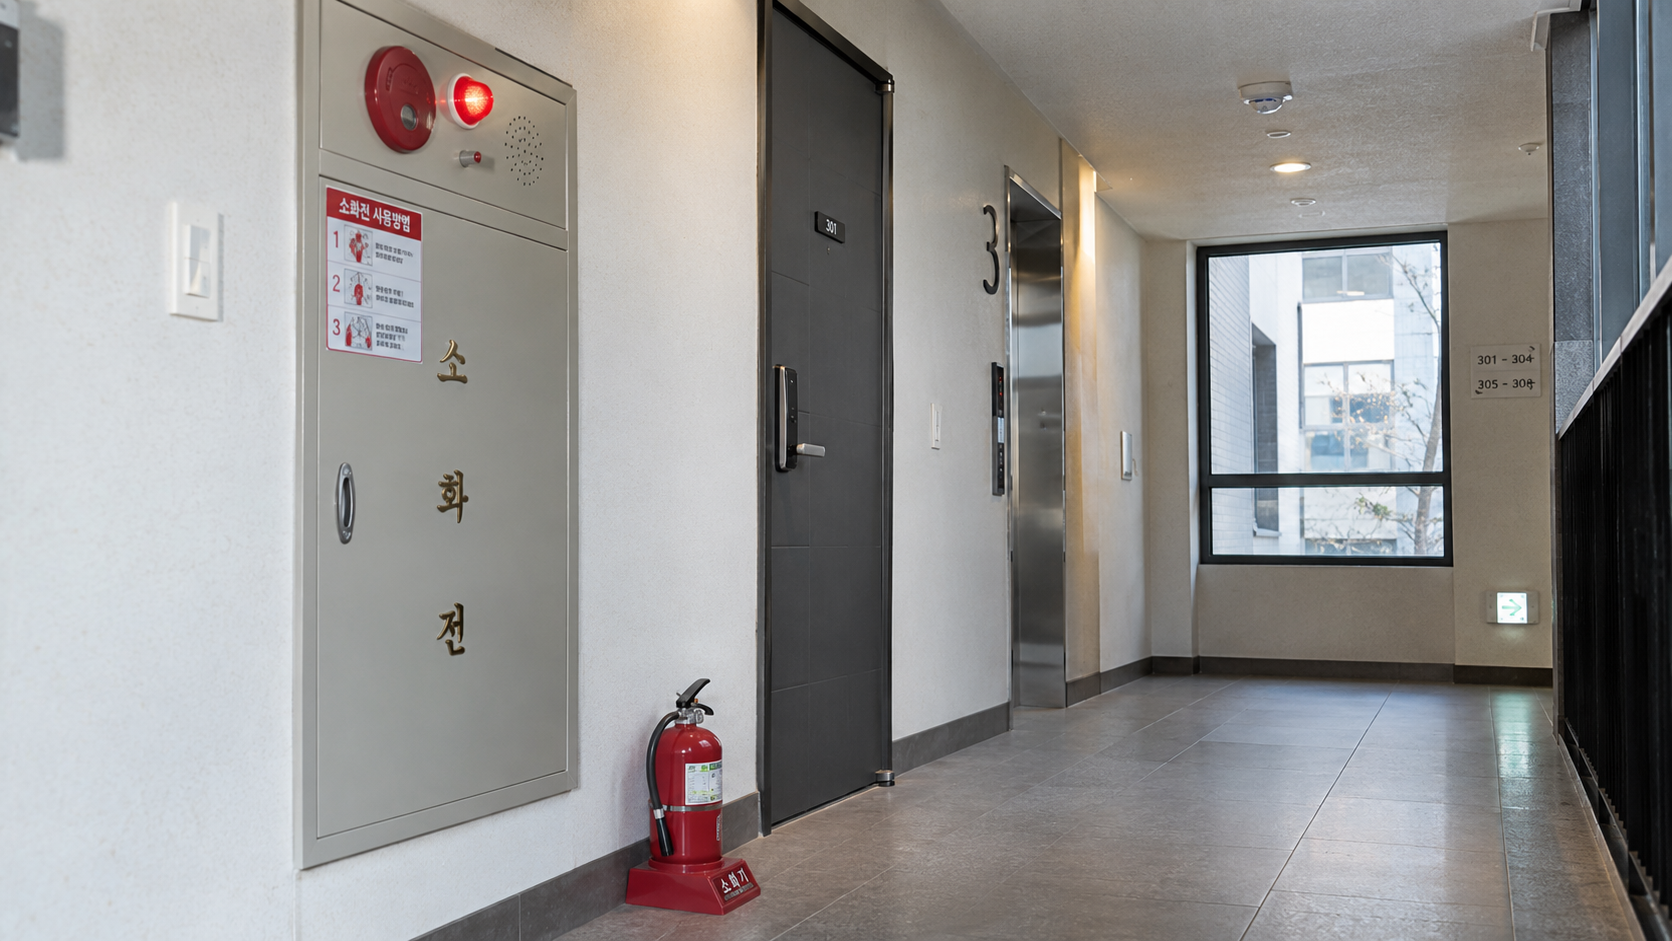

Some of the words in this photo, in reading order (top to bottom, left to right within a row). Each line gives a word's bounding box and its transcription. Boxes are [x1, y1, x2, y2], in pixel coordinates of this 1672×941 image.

[825, 218, 837, 235] 301
[333, 230, 339, 249] 1
[983, 205, 1000, 295] 3
[332, 274, 341, 293] 2
[332, 318, 341, 336] 3
[1477, 354, 1497, 365] 301
[1511, 353, 1535, 364] 304
[1477, 379, 1499, 390] 305
